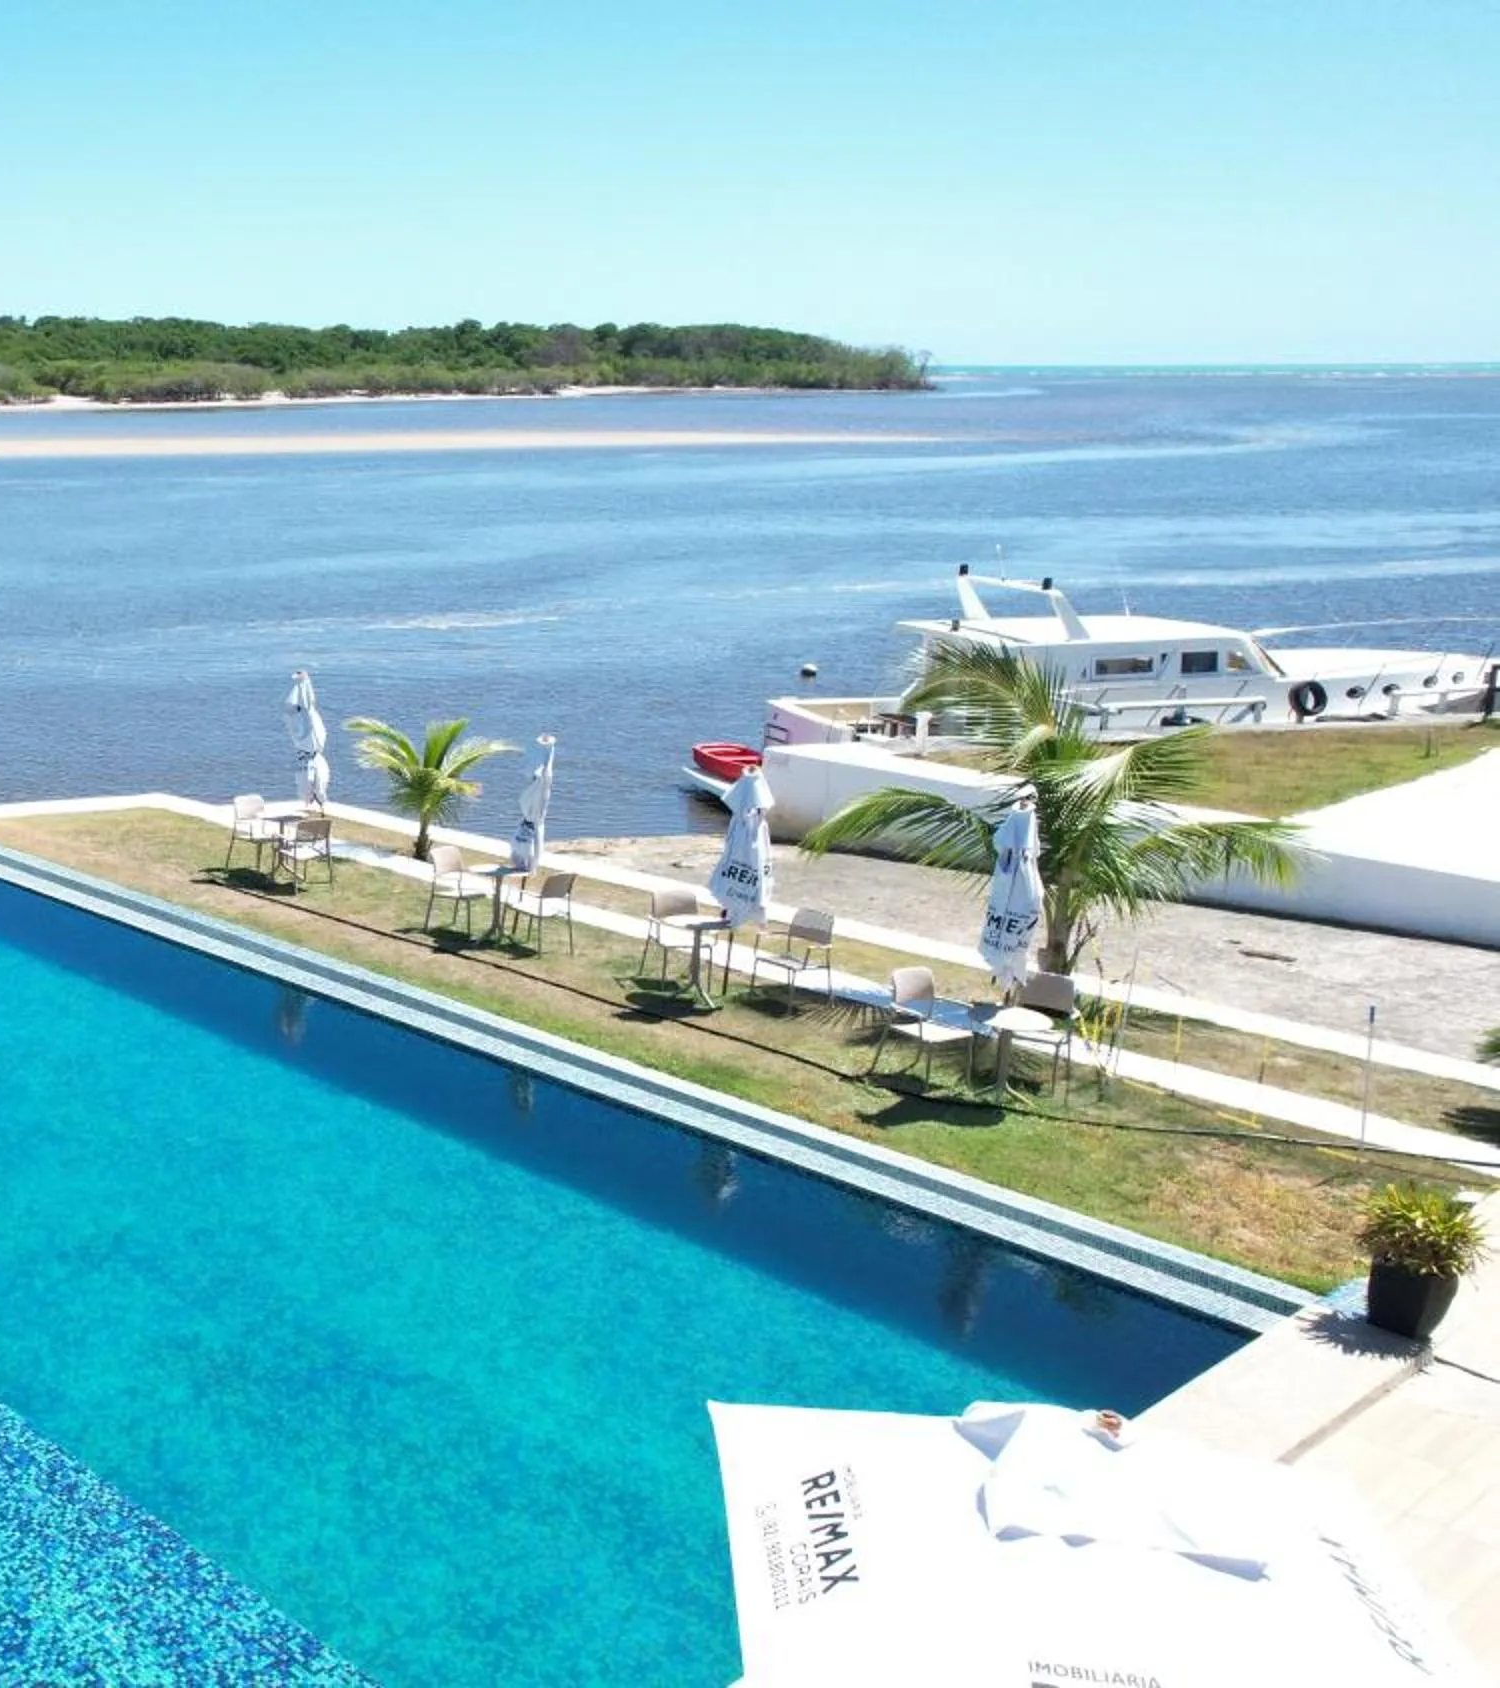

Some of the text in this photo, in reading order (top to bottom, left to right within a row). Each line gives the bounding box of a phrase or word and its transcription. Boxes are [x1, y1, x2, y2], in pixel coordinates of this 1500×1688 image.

[800, 1470, 859, 1595] RE/MAX
[789, 1541, 818, 1606] CORAIS
[1027, 1660, 1163, 1688] IMOBILIARIA
